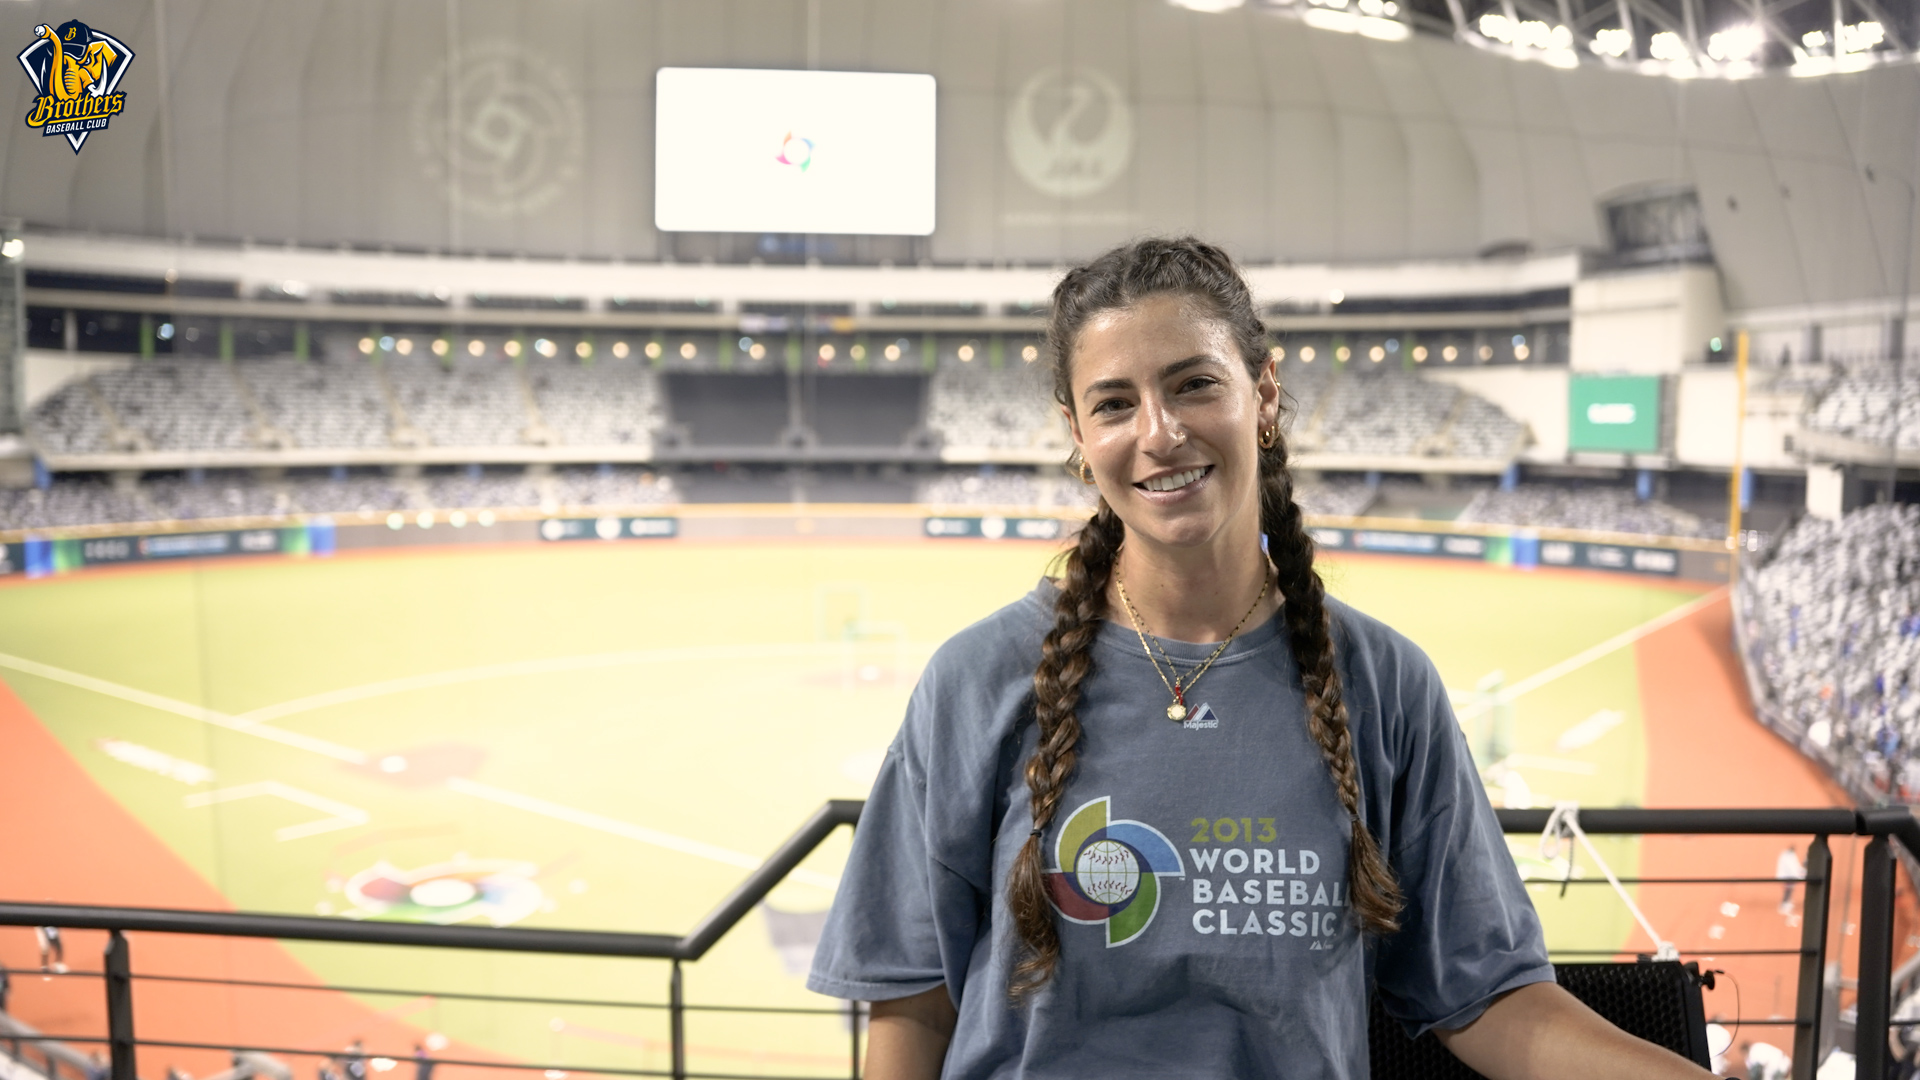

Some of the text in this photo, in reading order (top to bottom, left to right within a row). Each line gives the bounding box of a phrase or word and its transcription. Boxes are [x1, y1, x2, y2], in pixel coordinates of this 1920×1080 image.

[1183, 720, 1219, 731] Majestic
[1190, 817, 1277, 843] 2013
[1189, 848, 1320, 875] WORLD
[1192, 908, 1337, 937] CLASSIC
